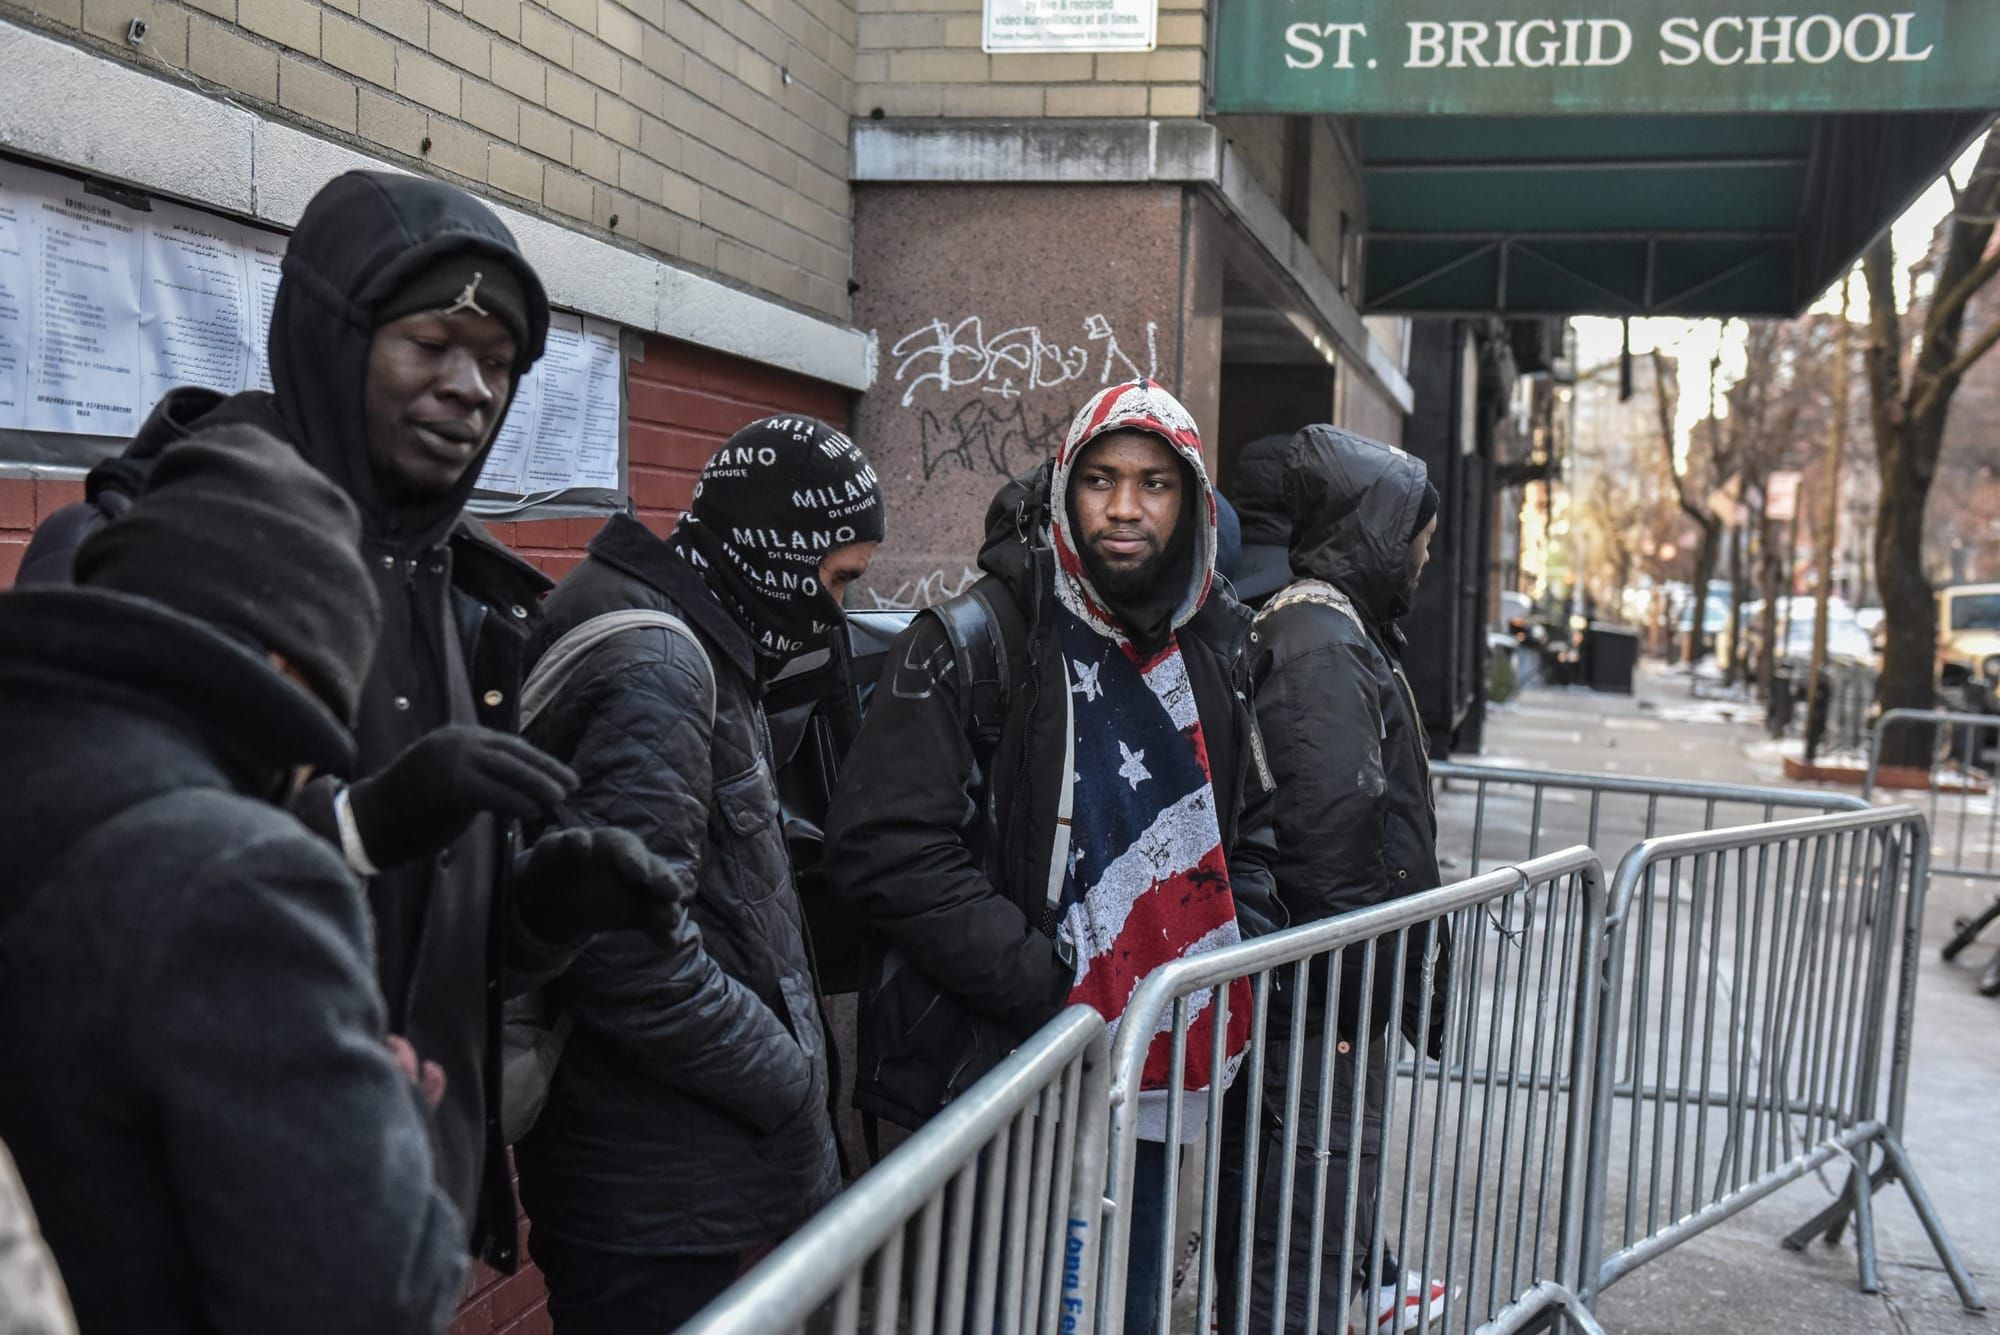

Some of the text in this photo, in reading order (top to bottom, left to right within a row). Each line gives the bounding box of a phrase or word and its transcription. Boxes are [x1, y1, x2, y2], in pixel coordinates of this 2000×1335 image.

[1284, 12, 1934, 69] ST. BRIGID SCHOOL
[792, 464, 878, 509] MILANO
[732, 525, 856, 550] MILANO
